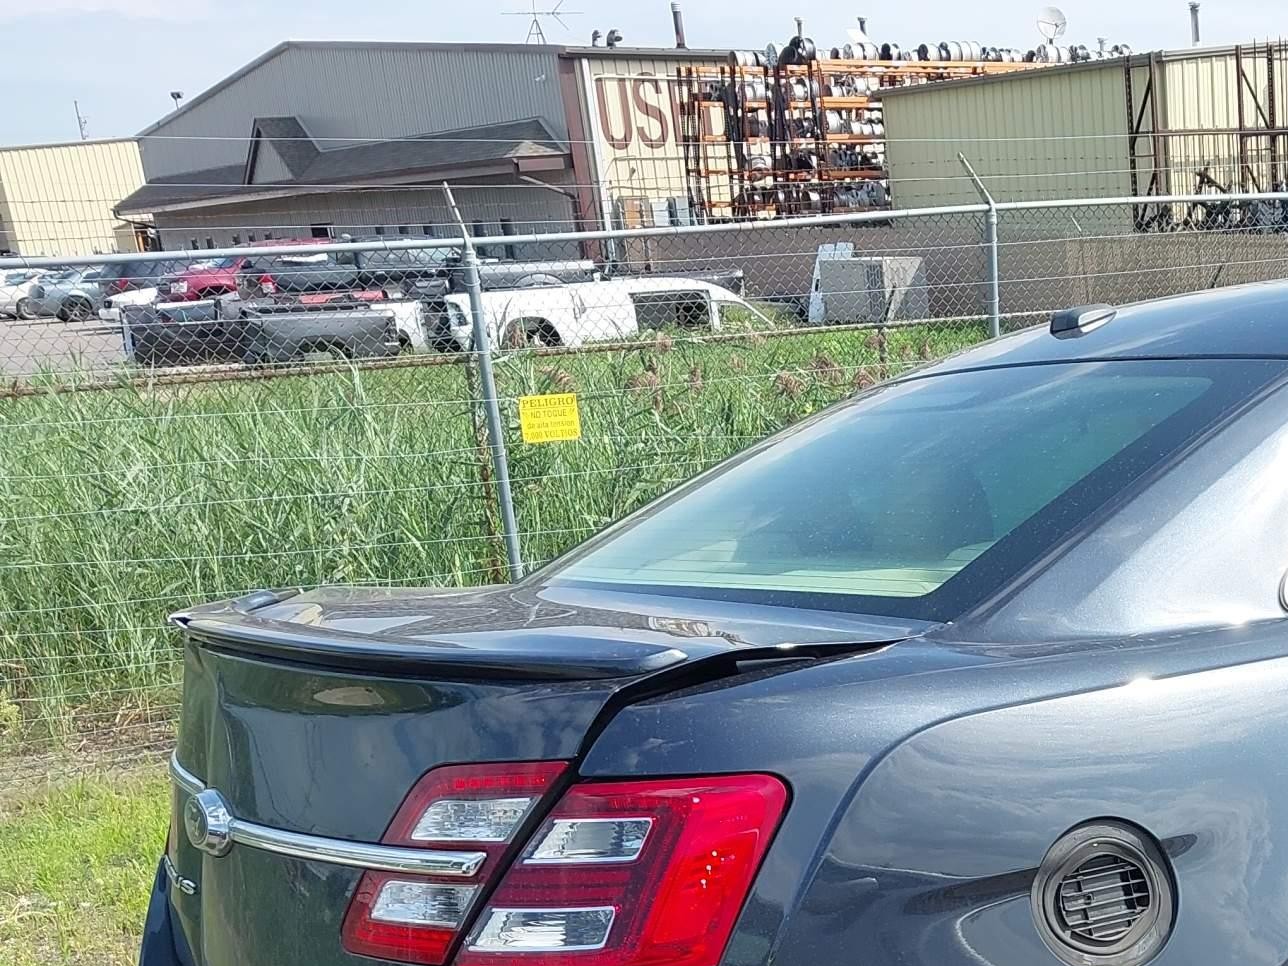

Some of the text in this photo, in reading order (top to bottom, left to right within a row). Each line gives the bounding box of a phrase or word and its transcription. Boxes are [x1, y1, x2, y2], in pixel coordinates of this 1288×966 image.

[522, 396, 574, 409] PELIGRO
[530, 409, 567, 419] NO TOQUE
[544, 428, 578, 439] VOLTIOS
